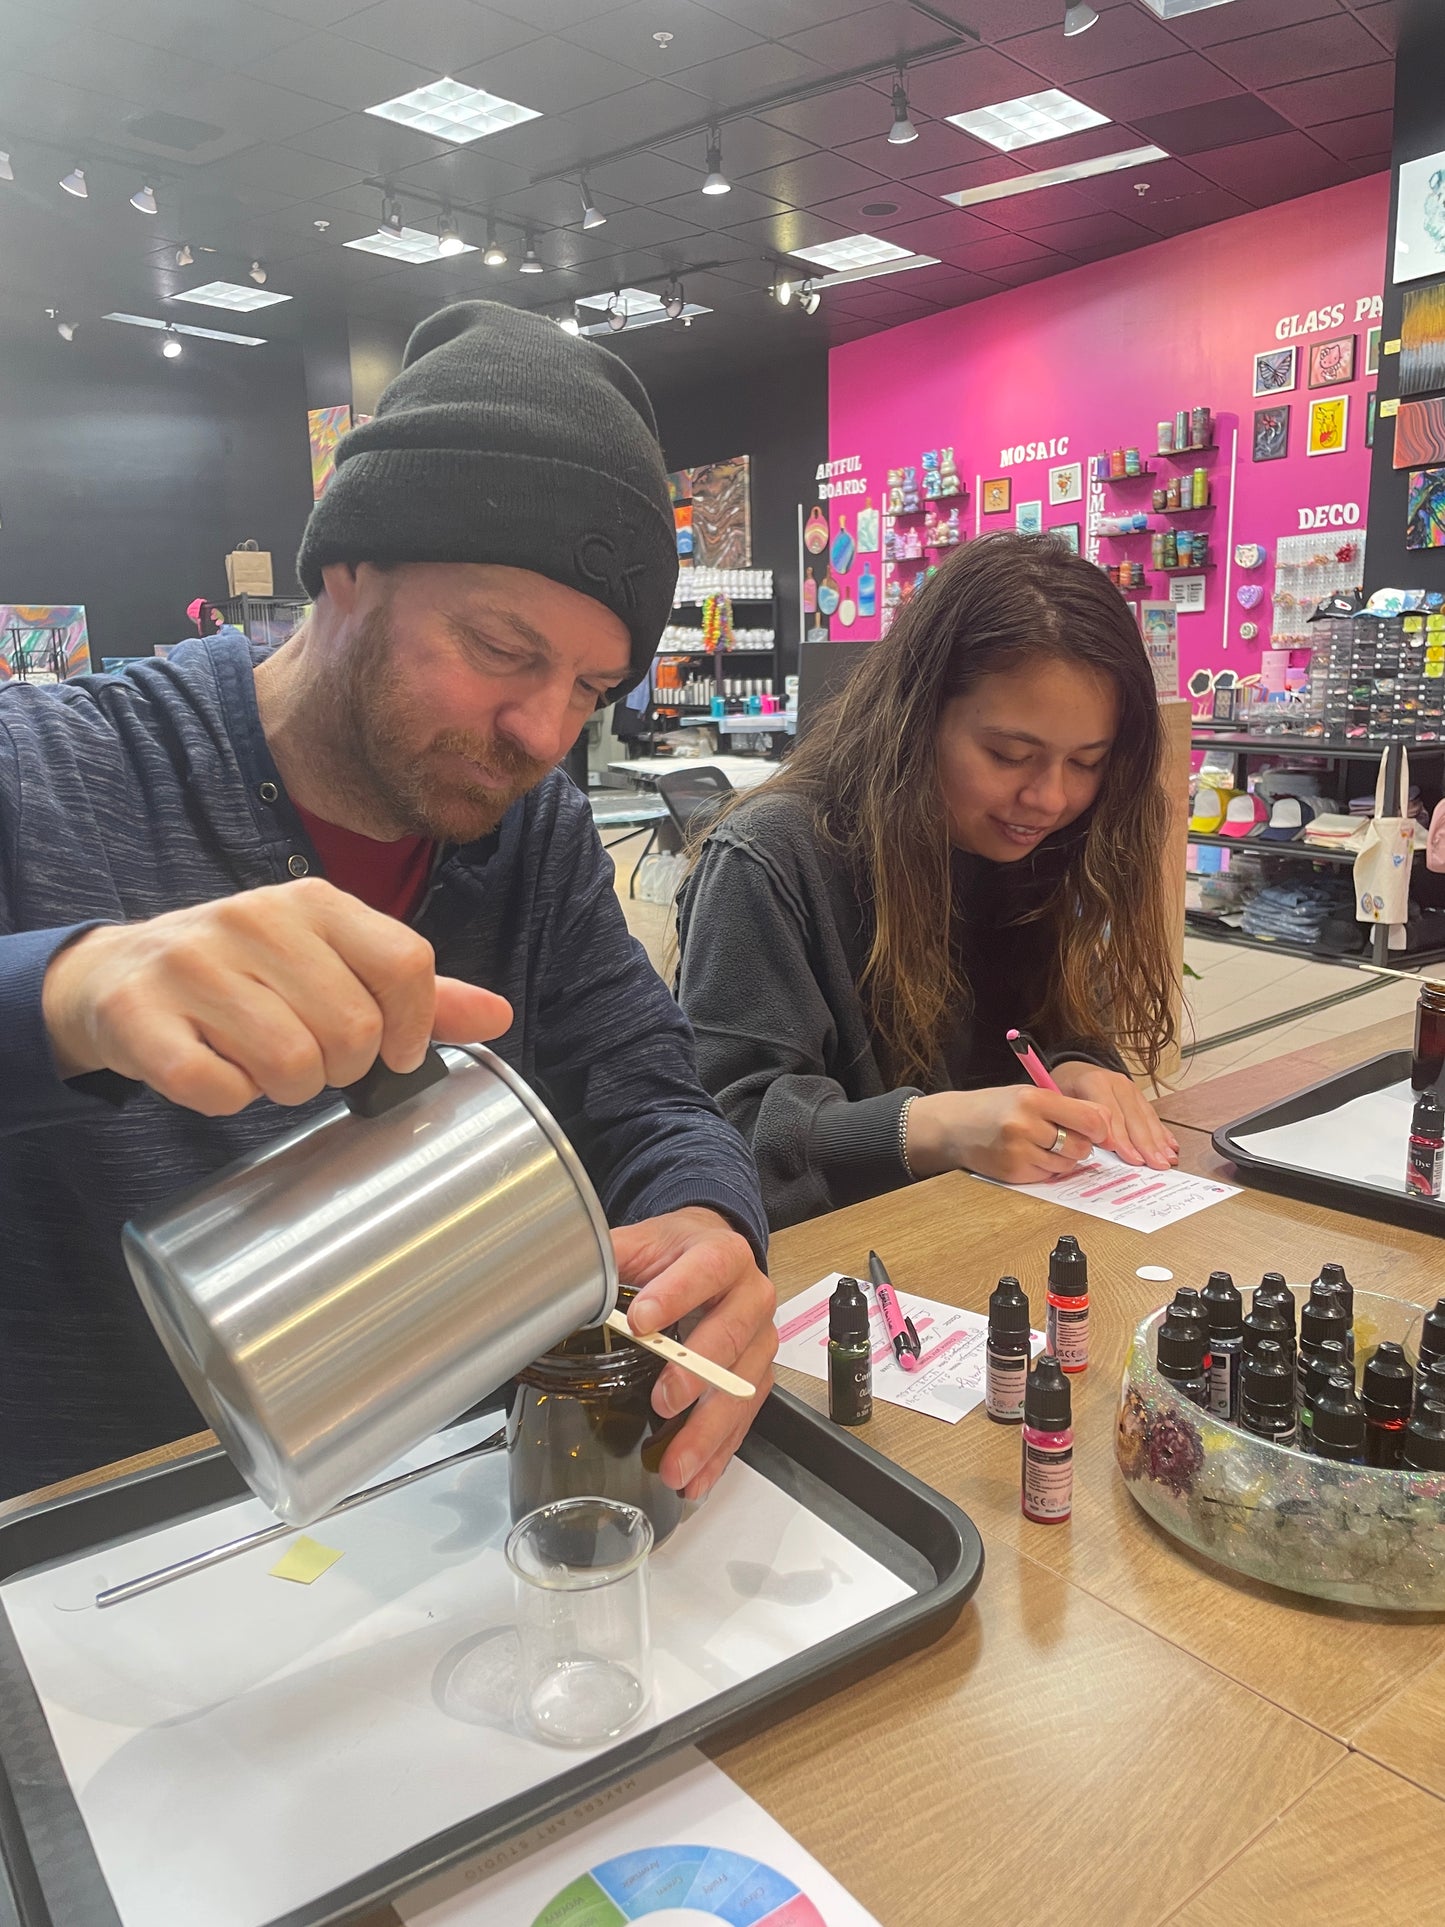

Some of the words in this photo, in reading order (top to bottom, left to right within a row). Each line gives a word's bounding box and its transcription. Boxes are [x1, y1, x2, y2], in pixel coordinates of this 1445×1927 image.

[1274, 303, 1345, 341] GLASS
[999, 436, 1070, 469] MOSAIC
[816, 456, 862, 480] ARTFUL
[818, 478, 868, 500] BOARDS
[1297, 503, 1360, 530] DECO
[1415, 1158, 1432, 1169] Dye
[573, 1778, 637, 1818] MAKERS
[536, 1818, 567, 1840] ART
[464, 1839, 530, 1880] STUDIO
